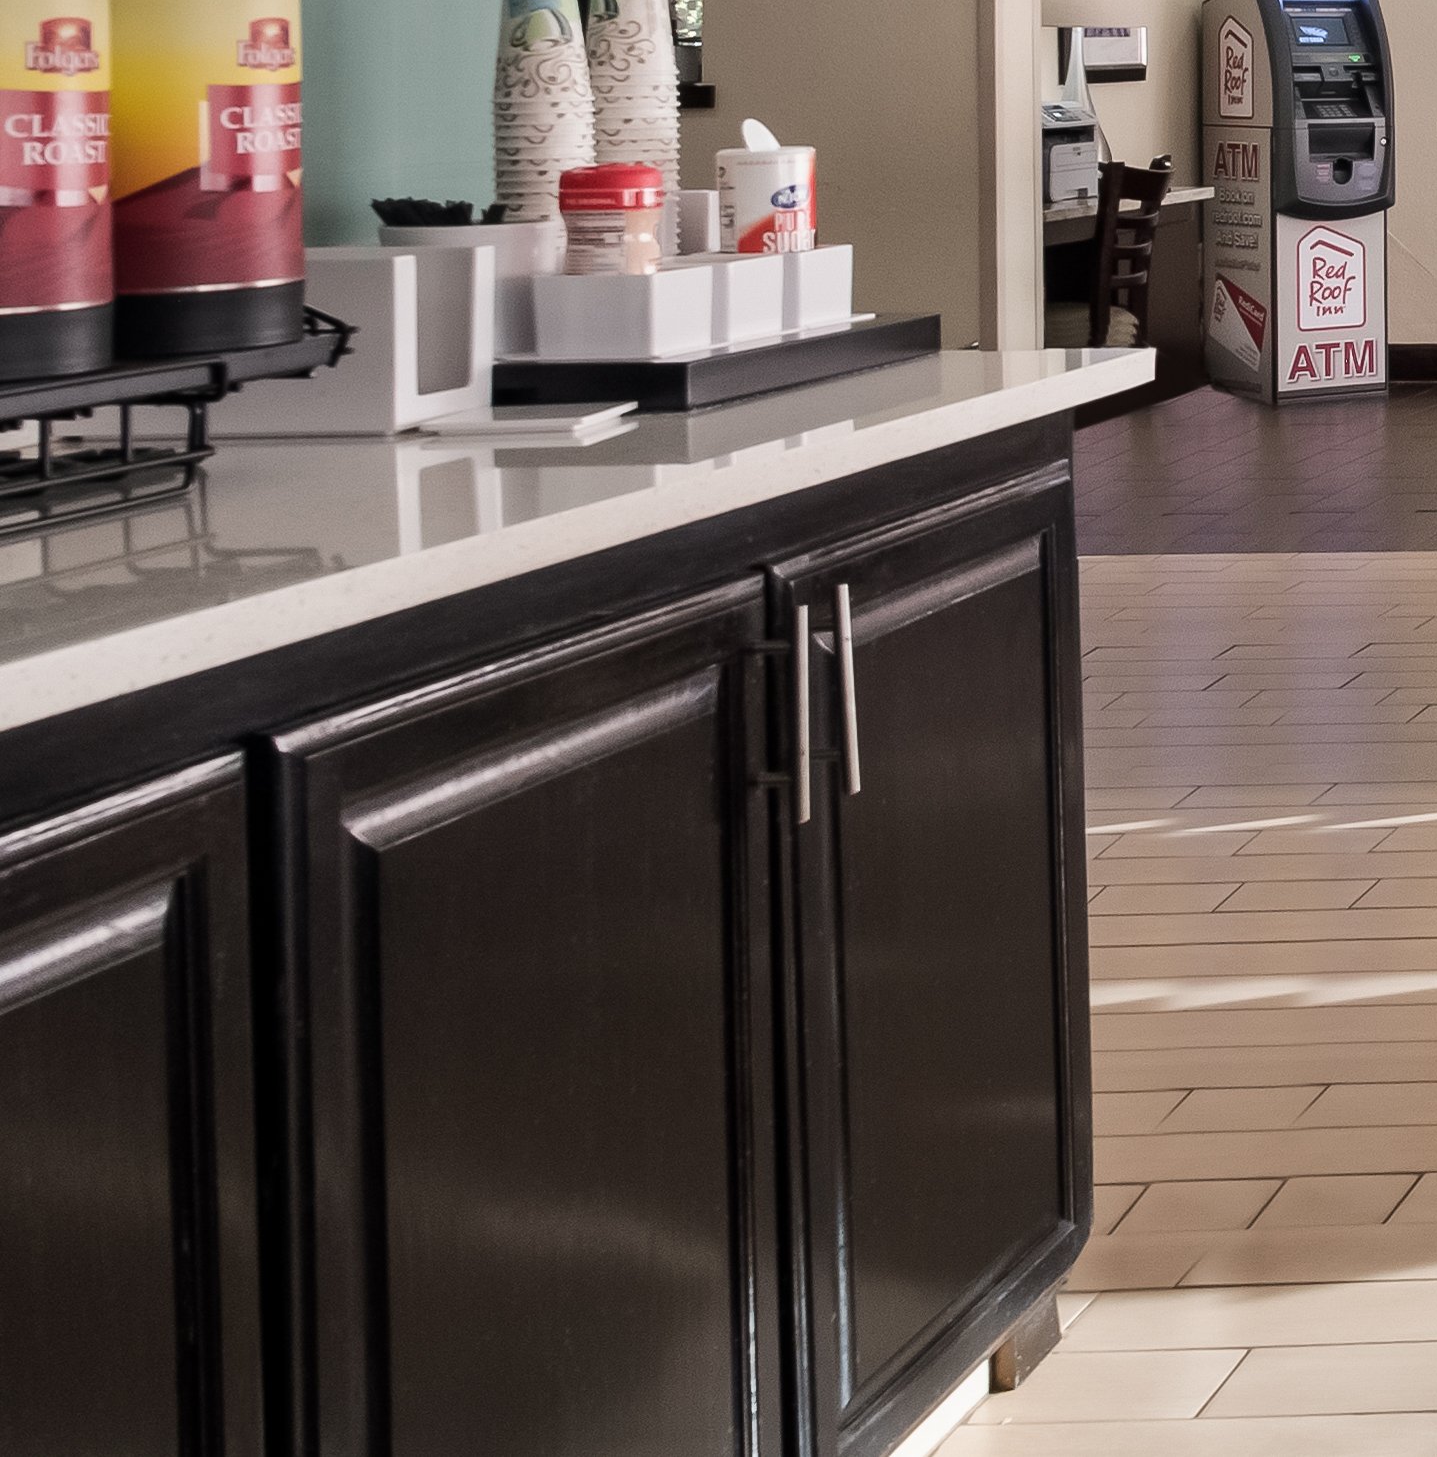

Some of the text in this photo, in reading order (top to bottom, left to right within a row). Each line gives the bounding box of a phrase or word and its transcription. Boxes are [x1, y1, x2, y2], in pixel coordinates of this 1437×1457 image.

[25, 41, 100, 75] Folgers
[237, 40, 296, 70] Folgers
[1226, 46, 1245, 70] Red
[1224, 67, 1249, 95] Roof
[1213, 142, 1259, 180] ATM
[1312, 257, 1348, 280] Red
[1309, 276, 1356, 307] Roof
[1287, 338, 1376, 383] ATM
